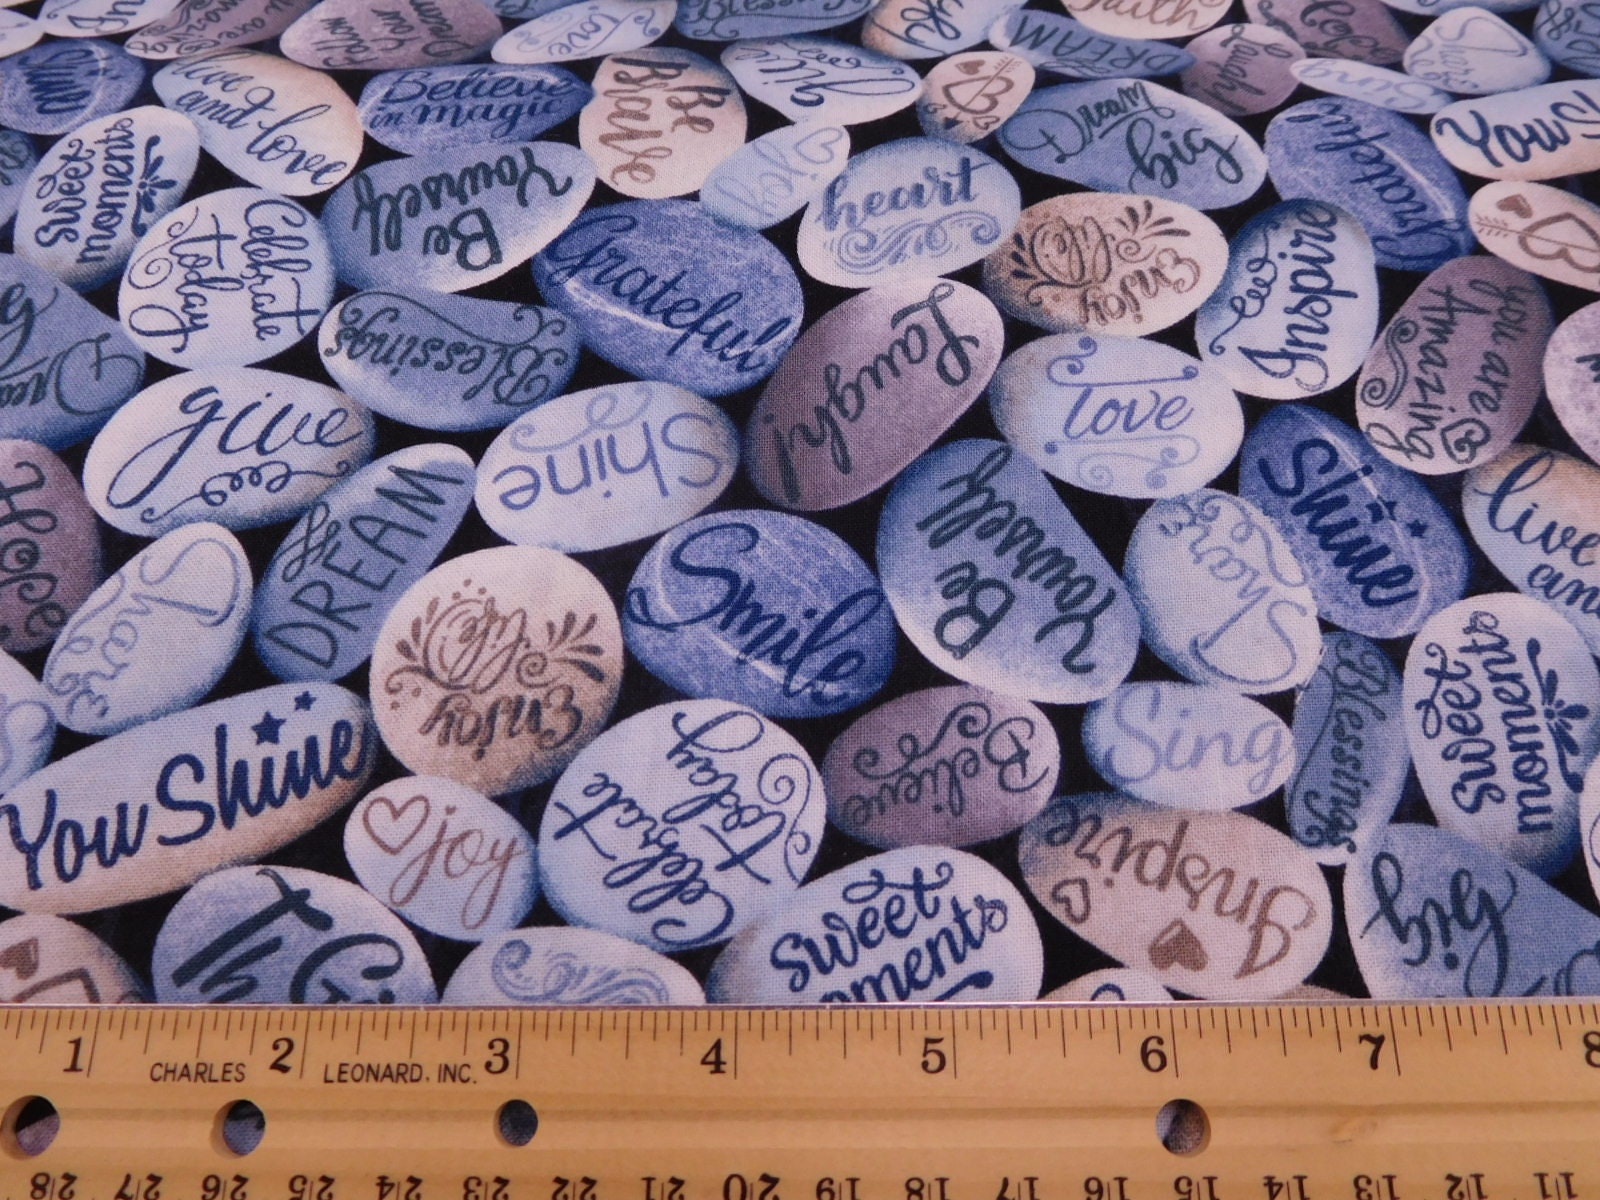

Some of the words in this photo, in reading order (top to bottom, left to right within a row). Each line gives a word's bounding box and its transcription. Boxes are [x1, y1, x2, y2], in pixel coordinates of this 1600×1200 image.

[1008, 15, 1185, 72] DREAM
[176, 86, 276, 131] and
[380, 67, 574, 104] Believe
[664, 84, 731, 134] Be
[369, 105, 404, 130] in
[410, 98, 563, 140] magic
[1000, 80, 1176, 165] Dream
[1434, 109, 1571, 168] You
[1128, 116, 1243, 195] big
[77, 117, 136, 264] moments
[352, 146, 573, 257] Yourself
[814, 156, 991, 232] heart
[422, 207, 503, 272] Be
[128, 210, 246, 353] today
[241, 199, 321, 342] Celebrate
[543, 214, 793, 373] Grateful
[1078, 246, 1201, 327] Enjoy
[1238, 199, 1359, 392] Inspire
[324, 306, 569, 407] Blessings
[1365, 284, 1489, 463] Amazing
[1468, 350, 1512, 414] are
[106, 385, 365, 509] give
[492, 411, 724, 511] Shine
[1257, 437, 1421, 608] Shine
[1475, 449, 1600, 568] live
[264, 464, 466, 670] DREAM
[915, 443, 1118, 675] Yourself
[626, 521, 885, 707] Smile
[933, 560, 1016, 660] Be
[419, 684, 584, 762] Enjoy
[1105, 687, 1286, 794] Sing
[1303, 637, 1391, 854] Blessings
[1459, 610, 1554, 835] moments
[665, 710, 787, 885] today
[848, 715, 1051, 827] Believe
[0, 788, 149, 890] You
[156, 720, 369, 846] Shine
[390, 804, 526, 931] joy
[553, 772, 735, 947] Celebrate
[1045, 800, 1318, 980] Inspire
[62, 1036, 84, 1074] 1
[149, 1061, 247, 1083] CHARLES
[437, 1063, 478, 1084] INC.
[269, 1037, 295, 1074] 2
[484, 1038, 510, 1074] 3
[700, 1037, 727, 1075] 4
[920, 1037, 947, 1074] 5
[1140, 1035, 1168, 1073] 6
[1358, 1033, 1386, 1071] 7
[1582, 1030, 1600, 1068] 8
[30, 1172, 78, 1200] 28
[114, 1172, 163, 1200] 27
[201, 1174, 249, 1200] 26
[288, 1174, 335, 1200] 25
[375, 1174, 423, 1200] 24
[462, 1175, 511, 1200] 23
[551, 1175, 598, 1200] 22
[640, 1176, 686, 1200] 21
[722, 1172, 780, 1200] 20
[815, 1177, 861, 1200] 19
[904, 1176, 950, 1200] 18
[995, 1176, 1040, 1200] 17
[1083, 1176, 1129, 1200] 16
[1173, 1175, 1220, 1200] 15
[1262, 1174, 1311, 1200] 14
[1352, 1174, 1400, 1200] 13
[1444, 1173, 1488, 1200] 12
[1533, 1172, 1579, 1200] 11
